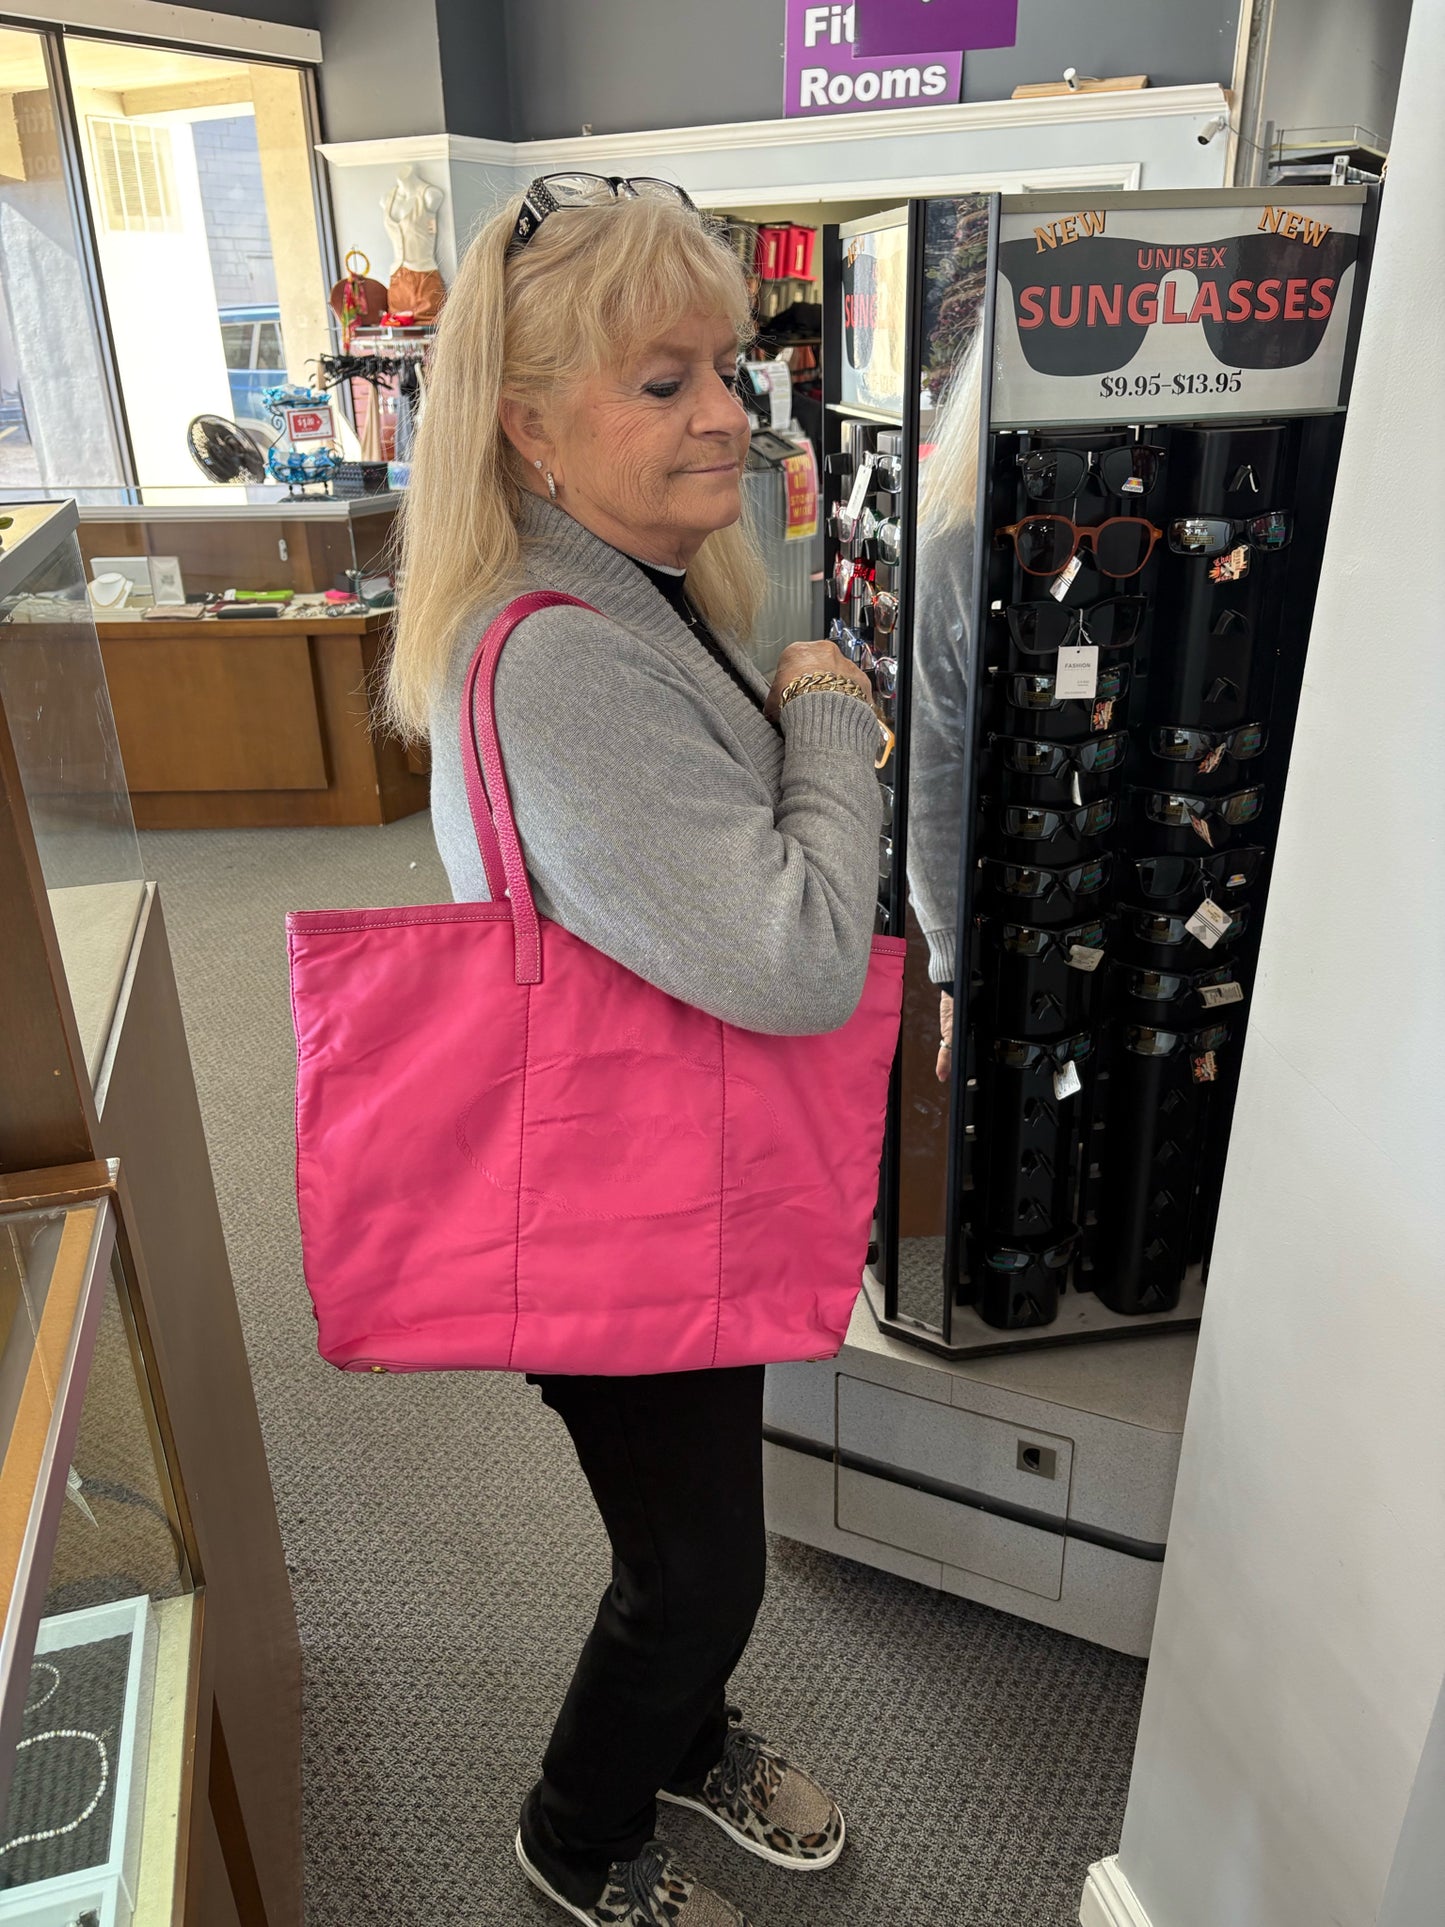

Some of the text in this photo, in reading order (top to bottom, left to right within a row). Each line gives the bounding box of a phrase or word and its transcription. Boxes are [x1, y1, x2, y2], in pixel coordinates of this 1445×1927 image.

[800, 65, 947, 107] Rooms
[1033, 209, 1107, 254] NEW
[1257, 205, 1331, 248] NEW
[1136, 247, 1228, 270] UNISEX
[1017, 277, 1336, 330] SUNGLASSES
